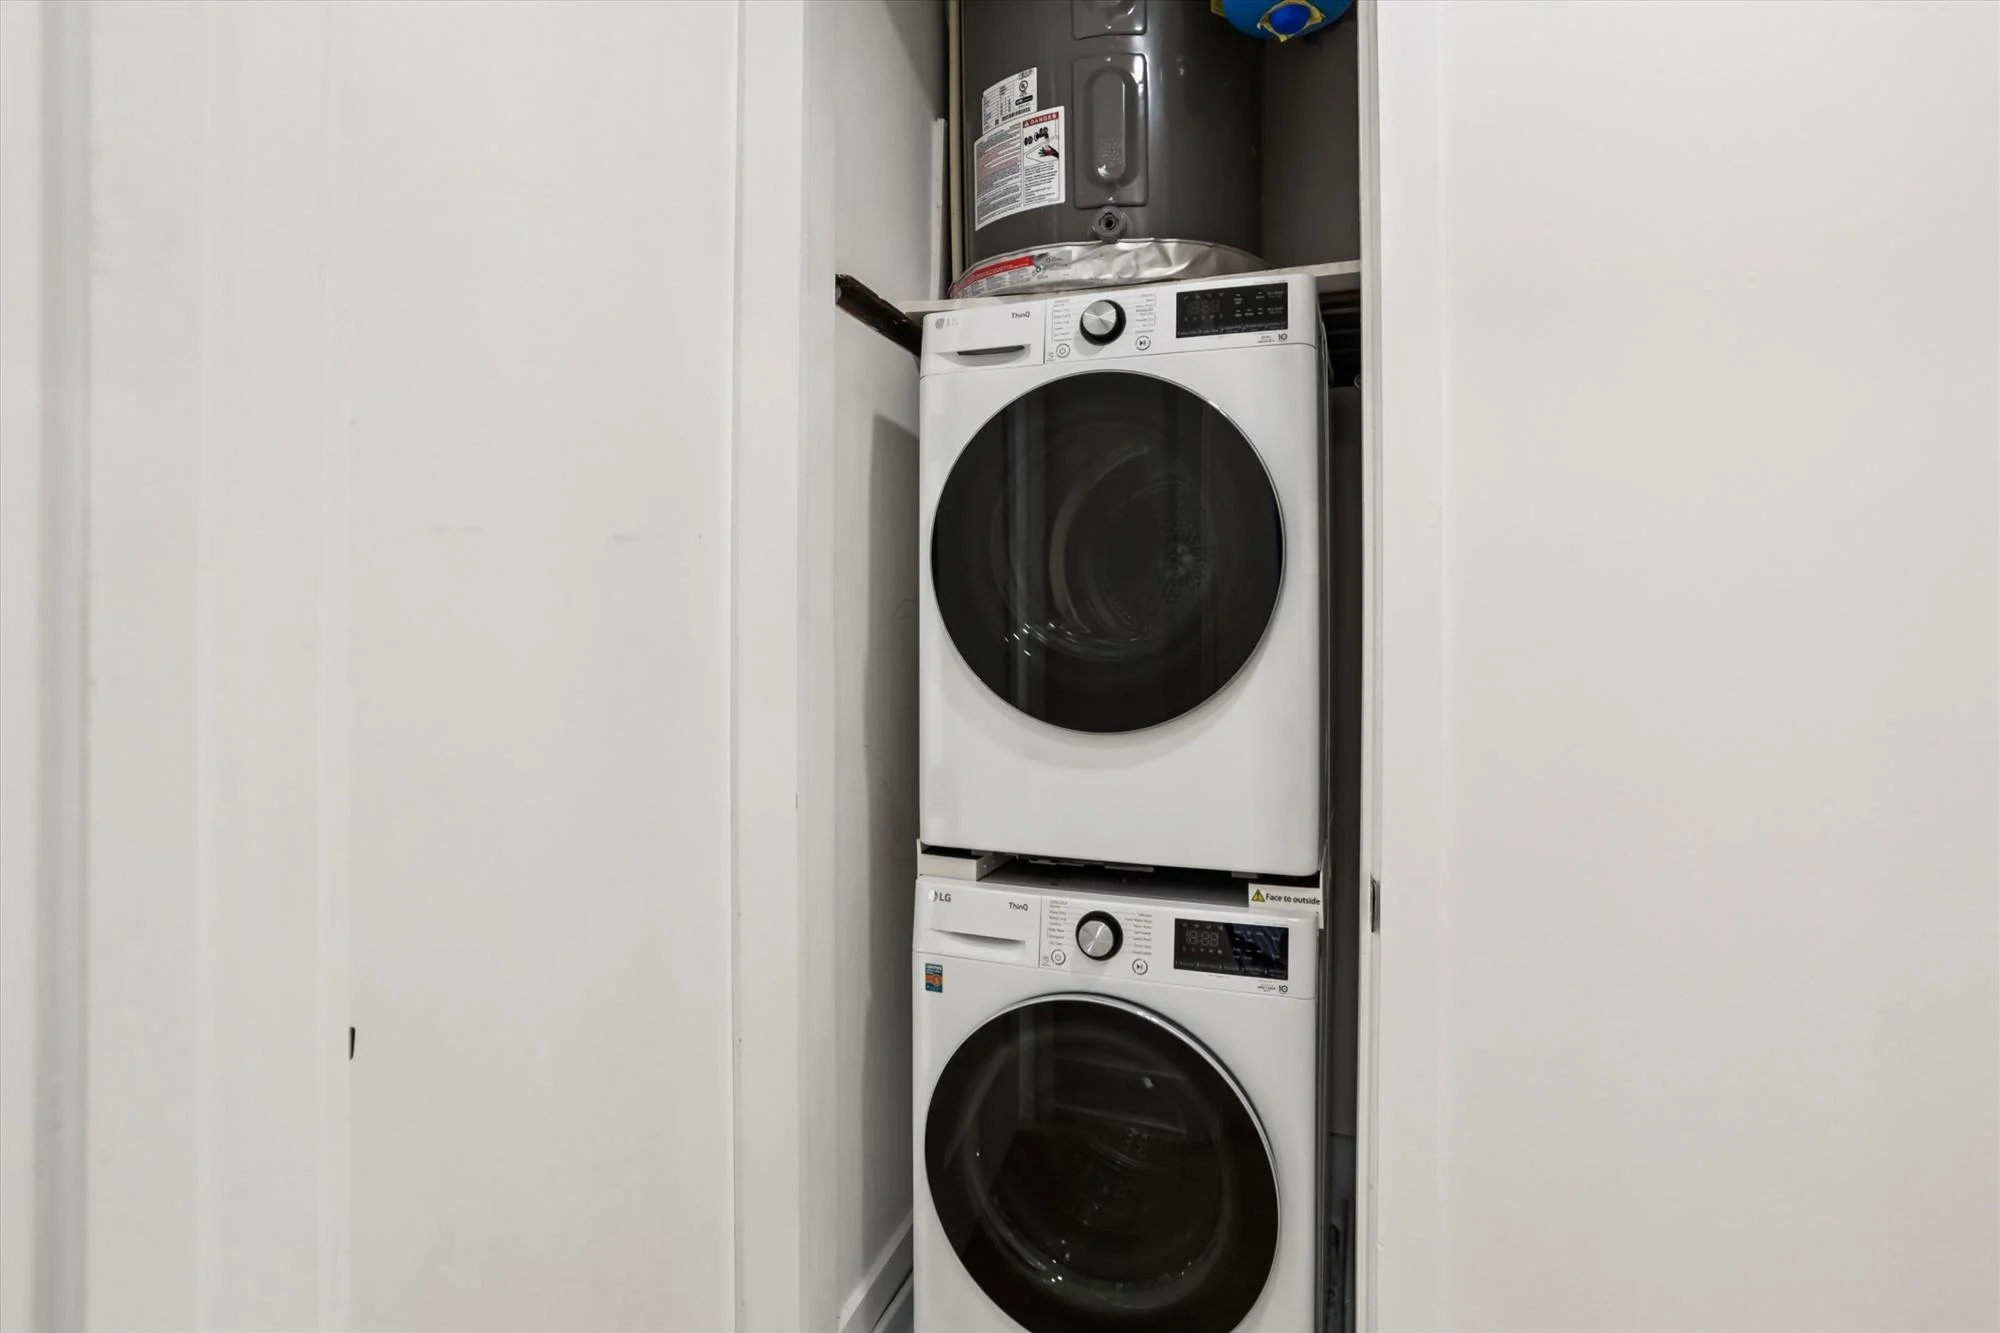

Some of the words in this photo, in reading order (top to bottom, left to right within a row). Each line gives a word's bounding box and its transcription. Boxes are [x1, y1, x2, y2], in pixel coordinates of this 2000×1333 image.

[1030, 113, 1058, 125] DANGER
[1011, 311, 1030, 320] ThinQ
[939, 893, 952, 902] LG
[1266, 892, 1283, 902] Face
[1293, 897, 1321, 905] outside
[1008, 902, 1029, 911] ThinQ
